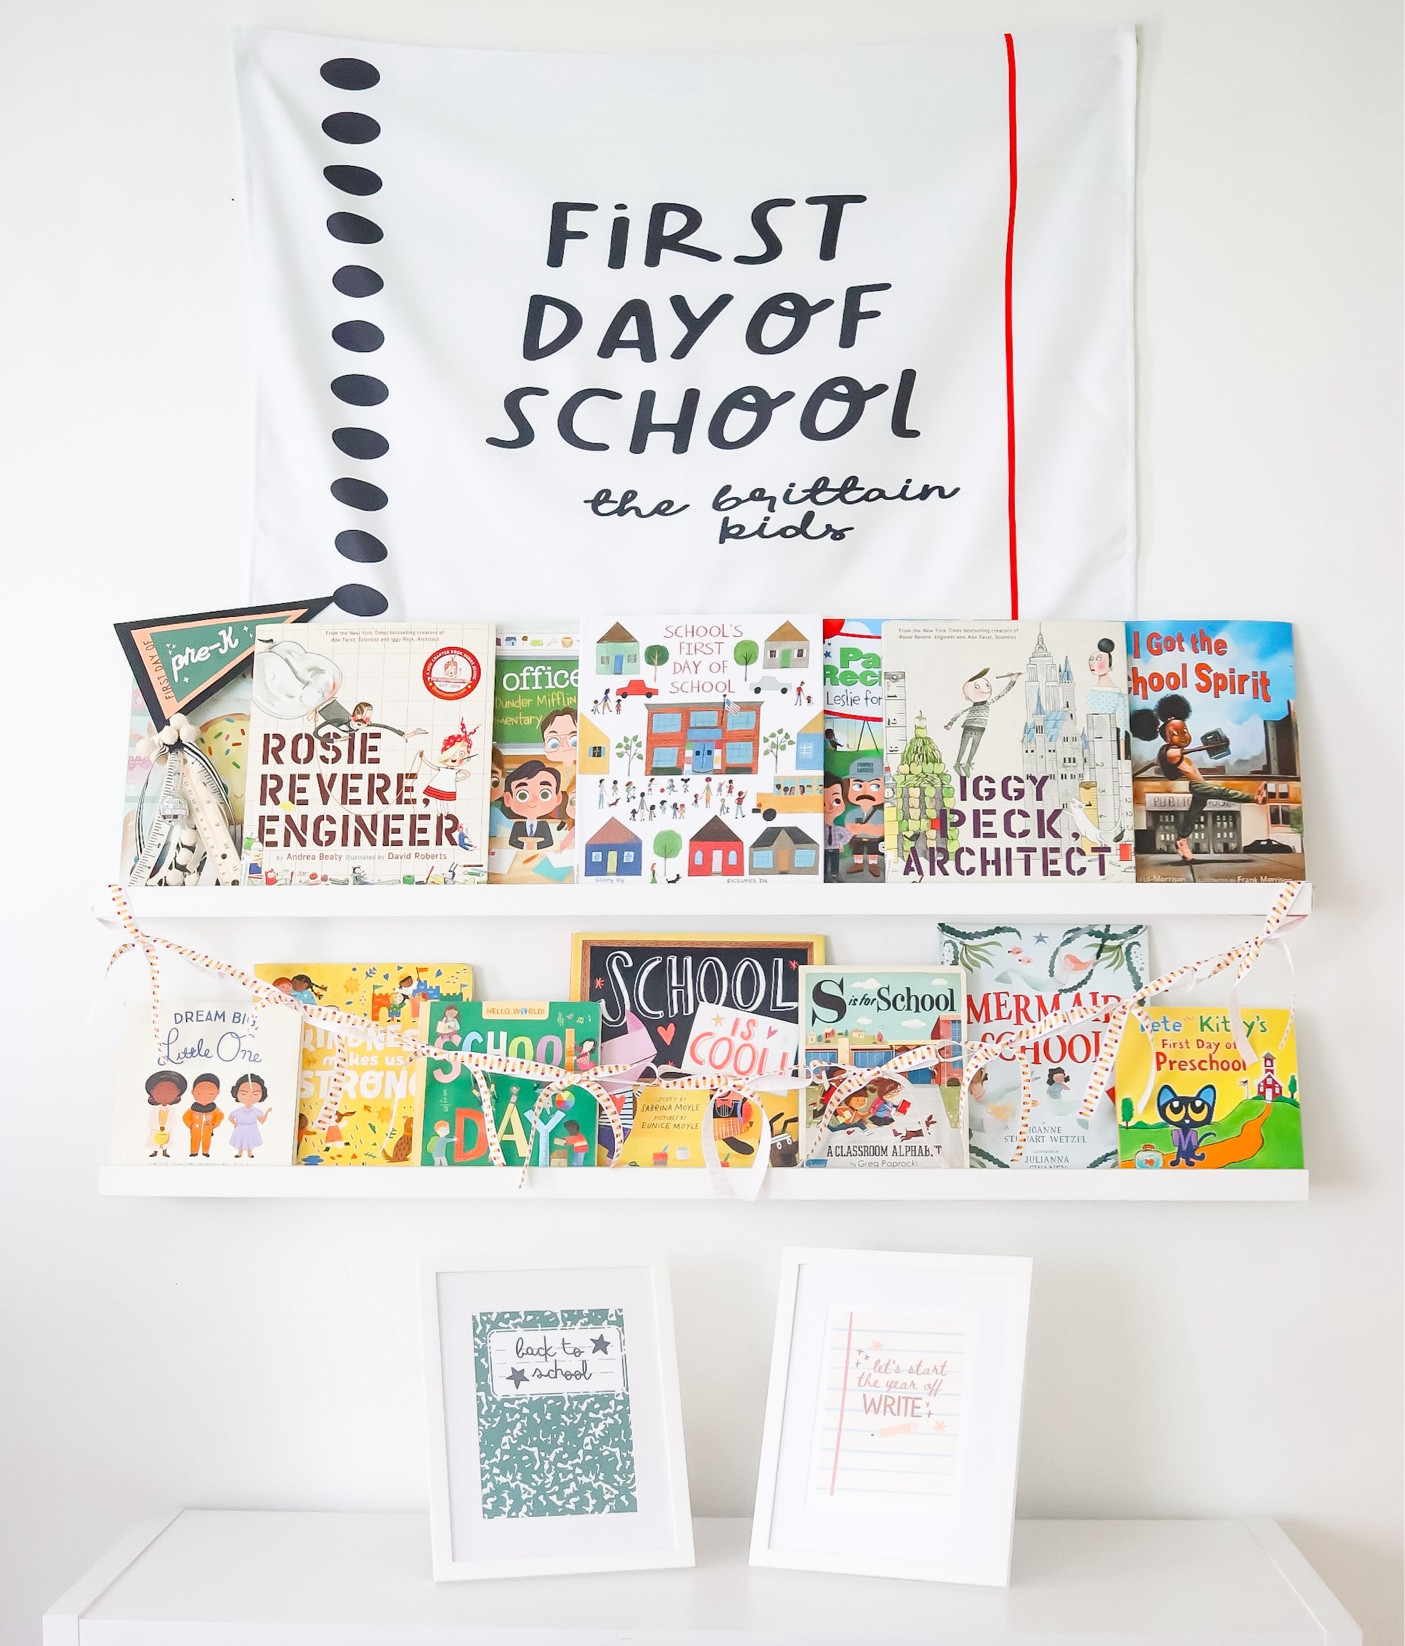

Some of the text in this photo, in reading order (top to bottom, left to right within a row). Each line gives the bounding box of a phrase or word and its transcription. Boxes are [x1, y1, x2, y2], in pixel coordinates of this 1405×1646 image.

[522, 282, 892, 363] DAY OF
[485, 368, 921, 455] SCHOOL
[583, 475, 961, 518] the brittain
[718, 511, 854, 544] kids
[663, 624, 744, 639] SCHOOL'S
[1133, 628, 1228, 659] I Got the
[170, 625, 239, 683] pre-K
[679, 641, 725, 656] FIRST
[143, 640, 175, 701] FIRST DAY OF
[671, 660, 729, 676] DAY OF
[668, 680, 736, 694] SCHOOL
[1194, 662, 1271, 703] Spirit
[826, 688, 883, 707] Leslie for
[261, 732, 383, 765] ROSIE
[258, 773, 431, 808] REVERE,
[959, 774, 1050, 801] IGGY
[257, 814, 460, 847] ENGINEER
[938, 808, 1081, 842] PECK,
[286, 853, 316, 861] Andrea
[319, 853, 343, 862] Beaty
[388, 852, 412, 860] David
[414, 852, 447, 860] Roberts
[903, 846, 1112, 876] ARCHITECT
[599, 950, 799, 1028] SCHOOL
[486, 1007, 512, 1015] HELLO,
[811, 976, 957, 1028] S is for School
[174, 1010, 226, 1024] DREAM
[730, 1016, 759, 1041] IS
[1199, 1015, 1268, 1038] Kity's
[157, 1027, 263, 1067] Little One
[322, 1051, 405, 1067] mkes us
[1161, 1038, 1191, 1050] First
[1196, 1038, 1220, 1055] Day
[1155, 1051, 1247, 1072] Preschool
[640, 1103, 700, 1112] SABRINA MOYLE
[453, 1102, 567, 1167] DAY
[641, 1121, 701, 1130] EUNICE MOYLE
[1028, 1126, 1062, 1134] JOANNE
[826, 1145, 834, 1158] A
[834, 1145, 889, 1158] CLASSROOM
[1004, 1135, 1088, 1143] START WETZEL
[857, 1160, 880, 1168] Greg
[881, 1160, 918, 1168] Paprocki
[1024, 1155, 1070, 1164] JULIANNA
[515, 1335, 585, 1362] back to
[531, 1358, 593, 1380] school
[873, 1358, 949, 1377] let's start
[856, 1371, 944, 1398] the year off
[862, 1392, 923, 1418] WRITE
